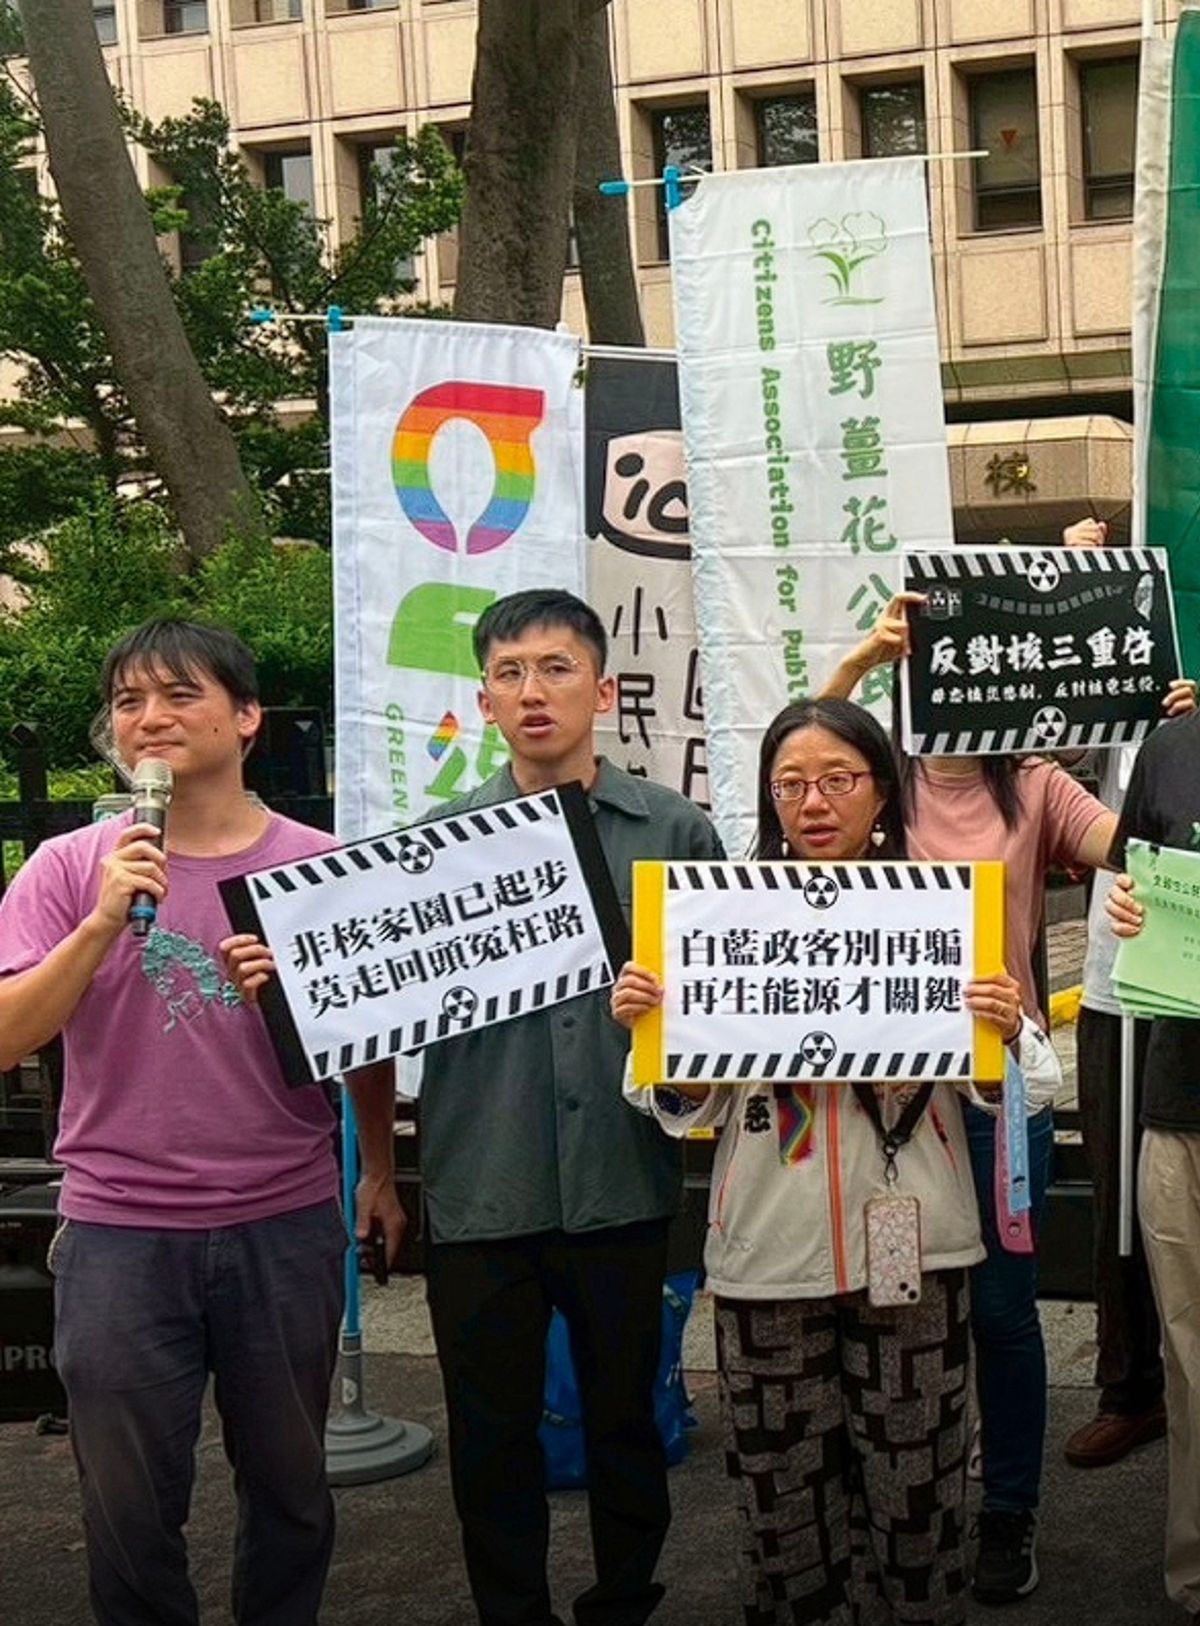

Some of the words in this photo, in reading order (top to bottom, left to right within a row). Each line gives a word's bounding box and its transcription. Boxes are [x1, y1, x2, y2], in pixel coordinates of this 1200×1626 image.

[751, 218, 777, 352] Citizens
[761, 366, 794, 548] Association
[776, 564, 799, 613] for
[611, 586, 668, 778] 小民
[385, 703, 408, 809] GREEN
[292, 860, 569, 974] 非核家園已起步
[303, 903, 586, 1019] 莫走回頭冤枉路
[681, 928, 963, 967] 白藍政客別再騙
[681, 976, 963, 1016] 再生能源才關鍵
